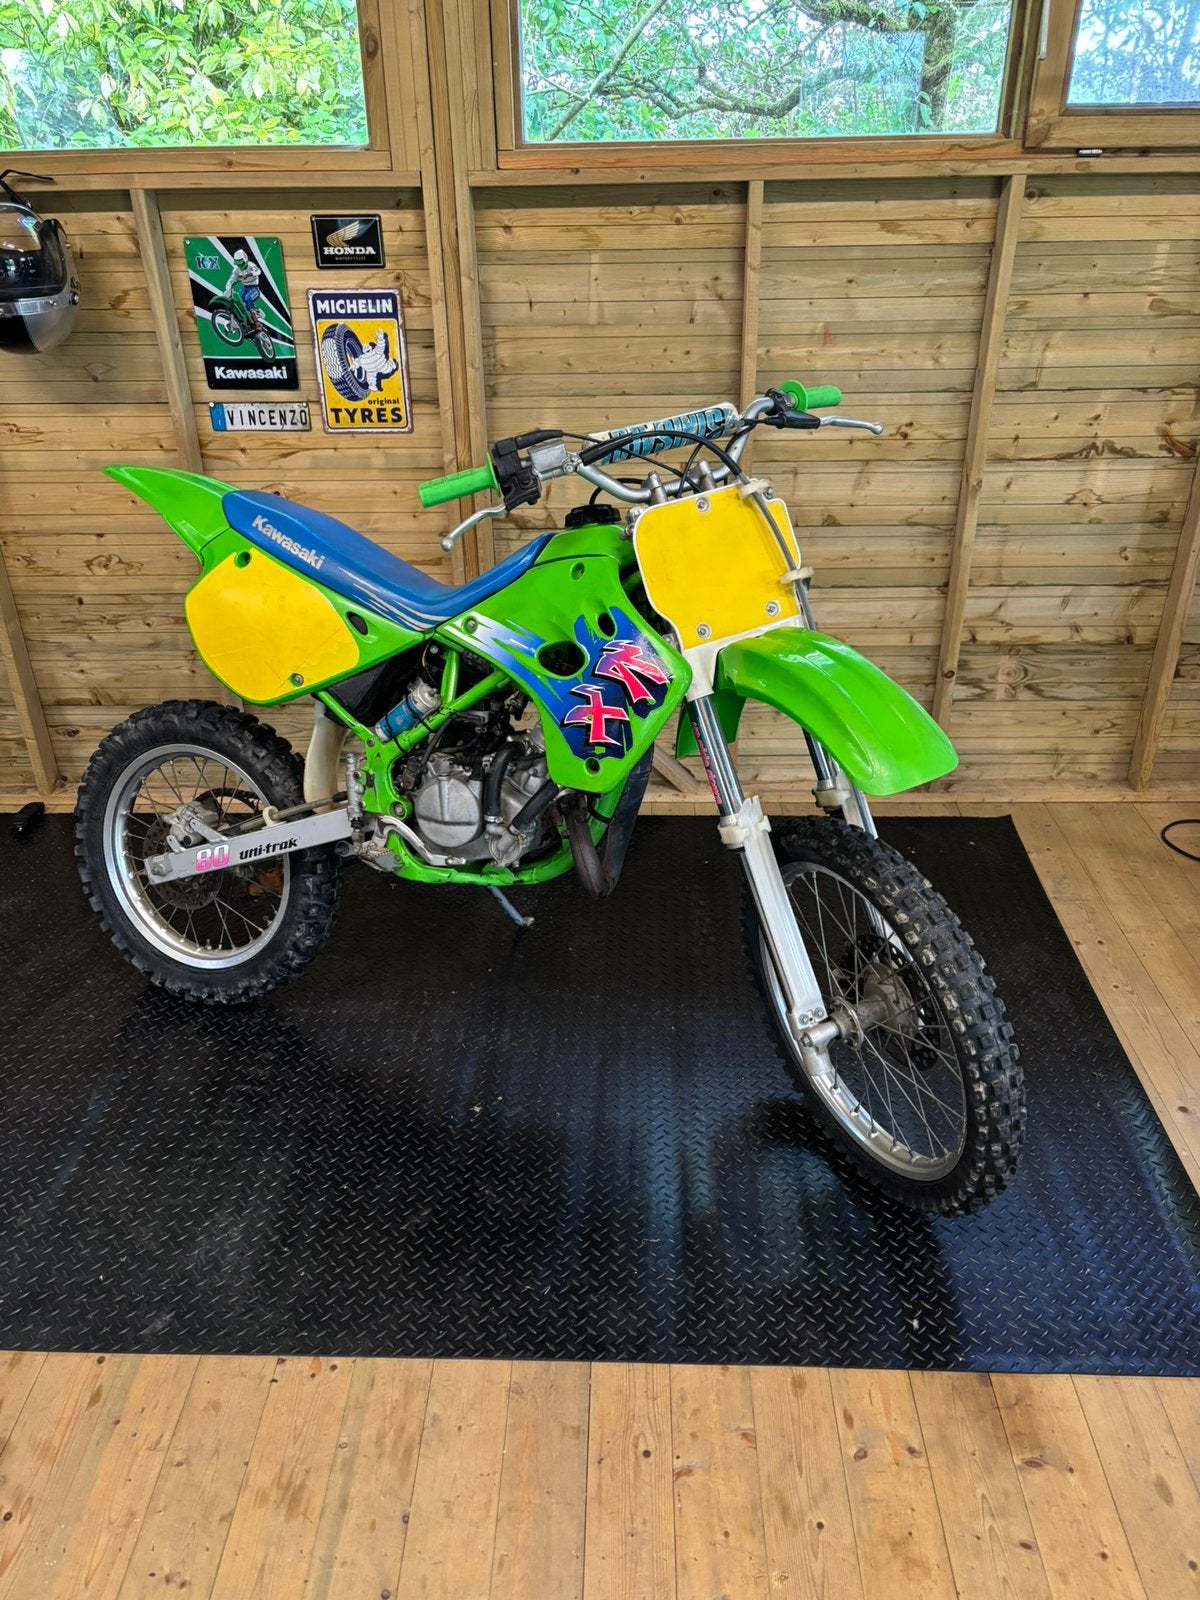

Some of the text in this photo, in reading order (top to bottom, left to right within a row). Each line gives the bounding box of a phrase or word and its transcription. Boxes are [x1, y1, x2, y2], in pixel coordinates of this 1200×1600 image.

[323, 246, 377, 255] HONDA
[195, 255, 221, 270] KX
[316, 298, 393, 314] MICHELIN
[214, 366, 288, 380] Kawasaki
[367, 397, 400, 406] original
[227, 409, 308, 426] VINCENZO
[330, 408, 403, 424] TYRES
[251, 514, 326, 570] Kawasaki
[195, 838, 299, 872] 80 uni-trak
